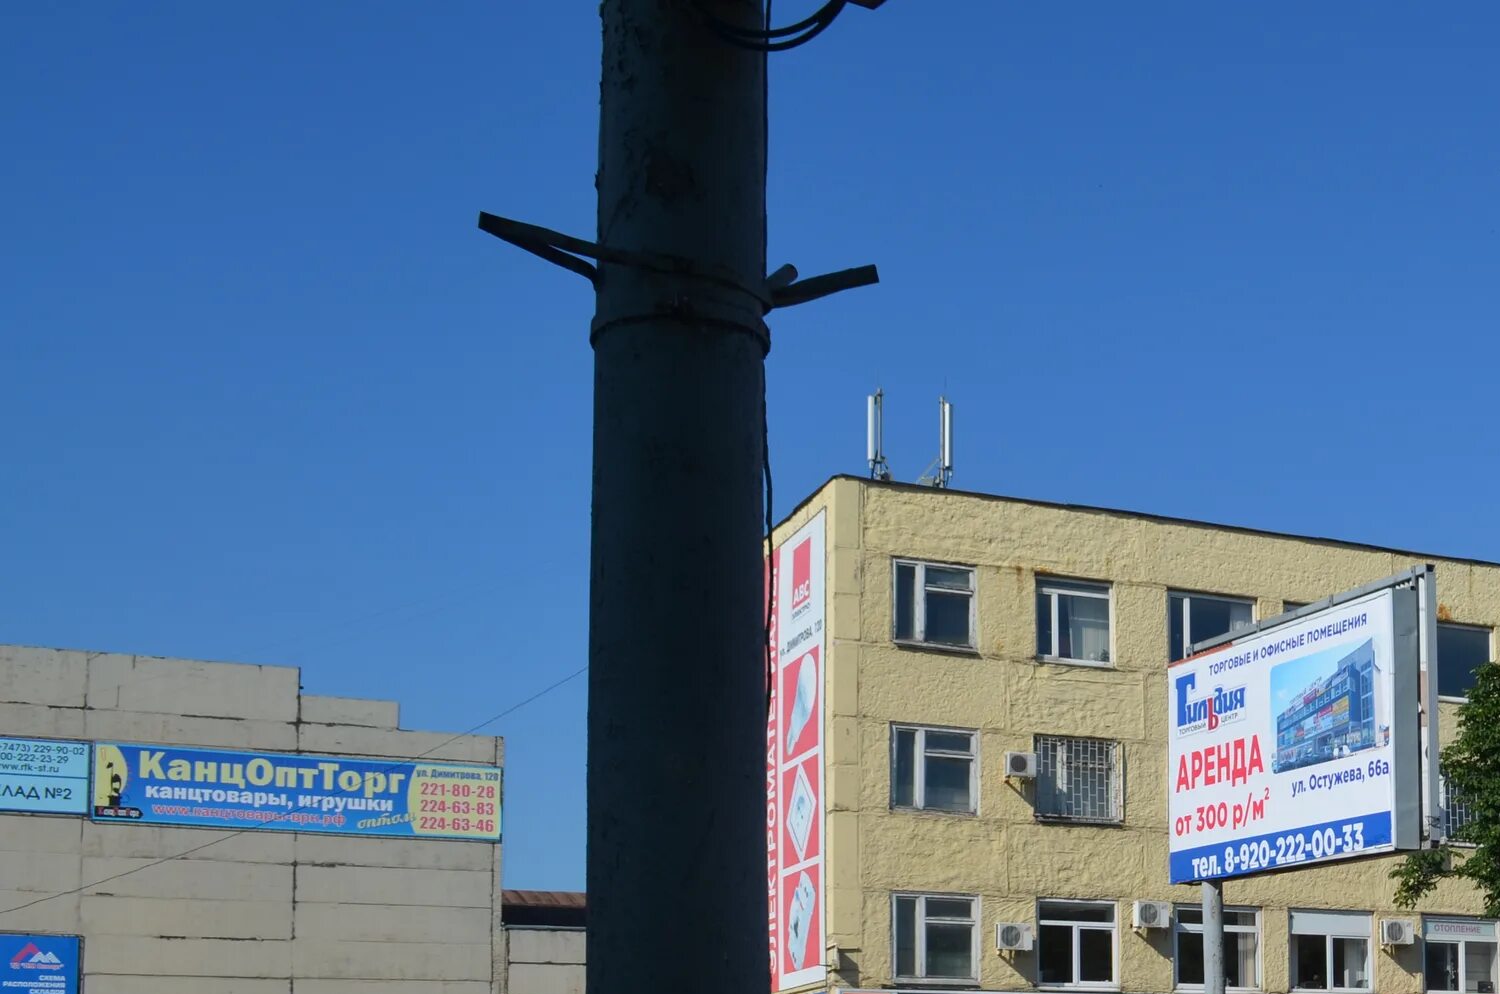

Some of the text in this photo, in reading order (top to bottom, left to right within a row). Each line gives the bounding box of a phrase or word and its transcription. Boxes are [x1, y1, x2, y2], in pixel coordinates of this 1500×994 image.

[1208, 613, 1368, 677] ТОРГОВЫЕ И ОФИСНЫЕ ПОМЕЩЕНИЯ
[1176, 672, 1246, 731] Гильдия
[0, 752, 69, 764] 00-222-23-29
[34, 744, 85, 756] 229-90-02
[1175, 734, 1264, 793] АРЕНДА
[139, 750, 406, 798] КанцОптТорг
[766, 567, 778, 975] ЭЛЕКТРОМАТЕИАЛЫ
[1291, 759, 1389, 797] ул. Остужева, 66а
[0, 784, 73, 800] ЛАД №2
[145, 784, 394, 812] канцтовары, игрушки
[420, 782, 495, 799] 221-80-28
[420, 799, 495, 816] 224-63-83
[1175, 813, 1191, 836] от
[1196, 801, 1228, 832] 300
[419, 816, 494, 833] 224-63-46
[1191, 821, 1365, 879] тел. 8-920-222-00-33
[1434, 924, 1481, 934] ОТОПЛЕНИЕ
